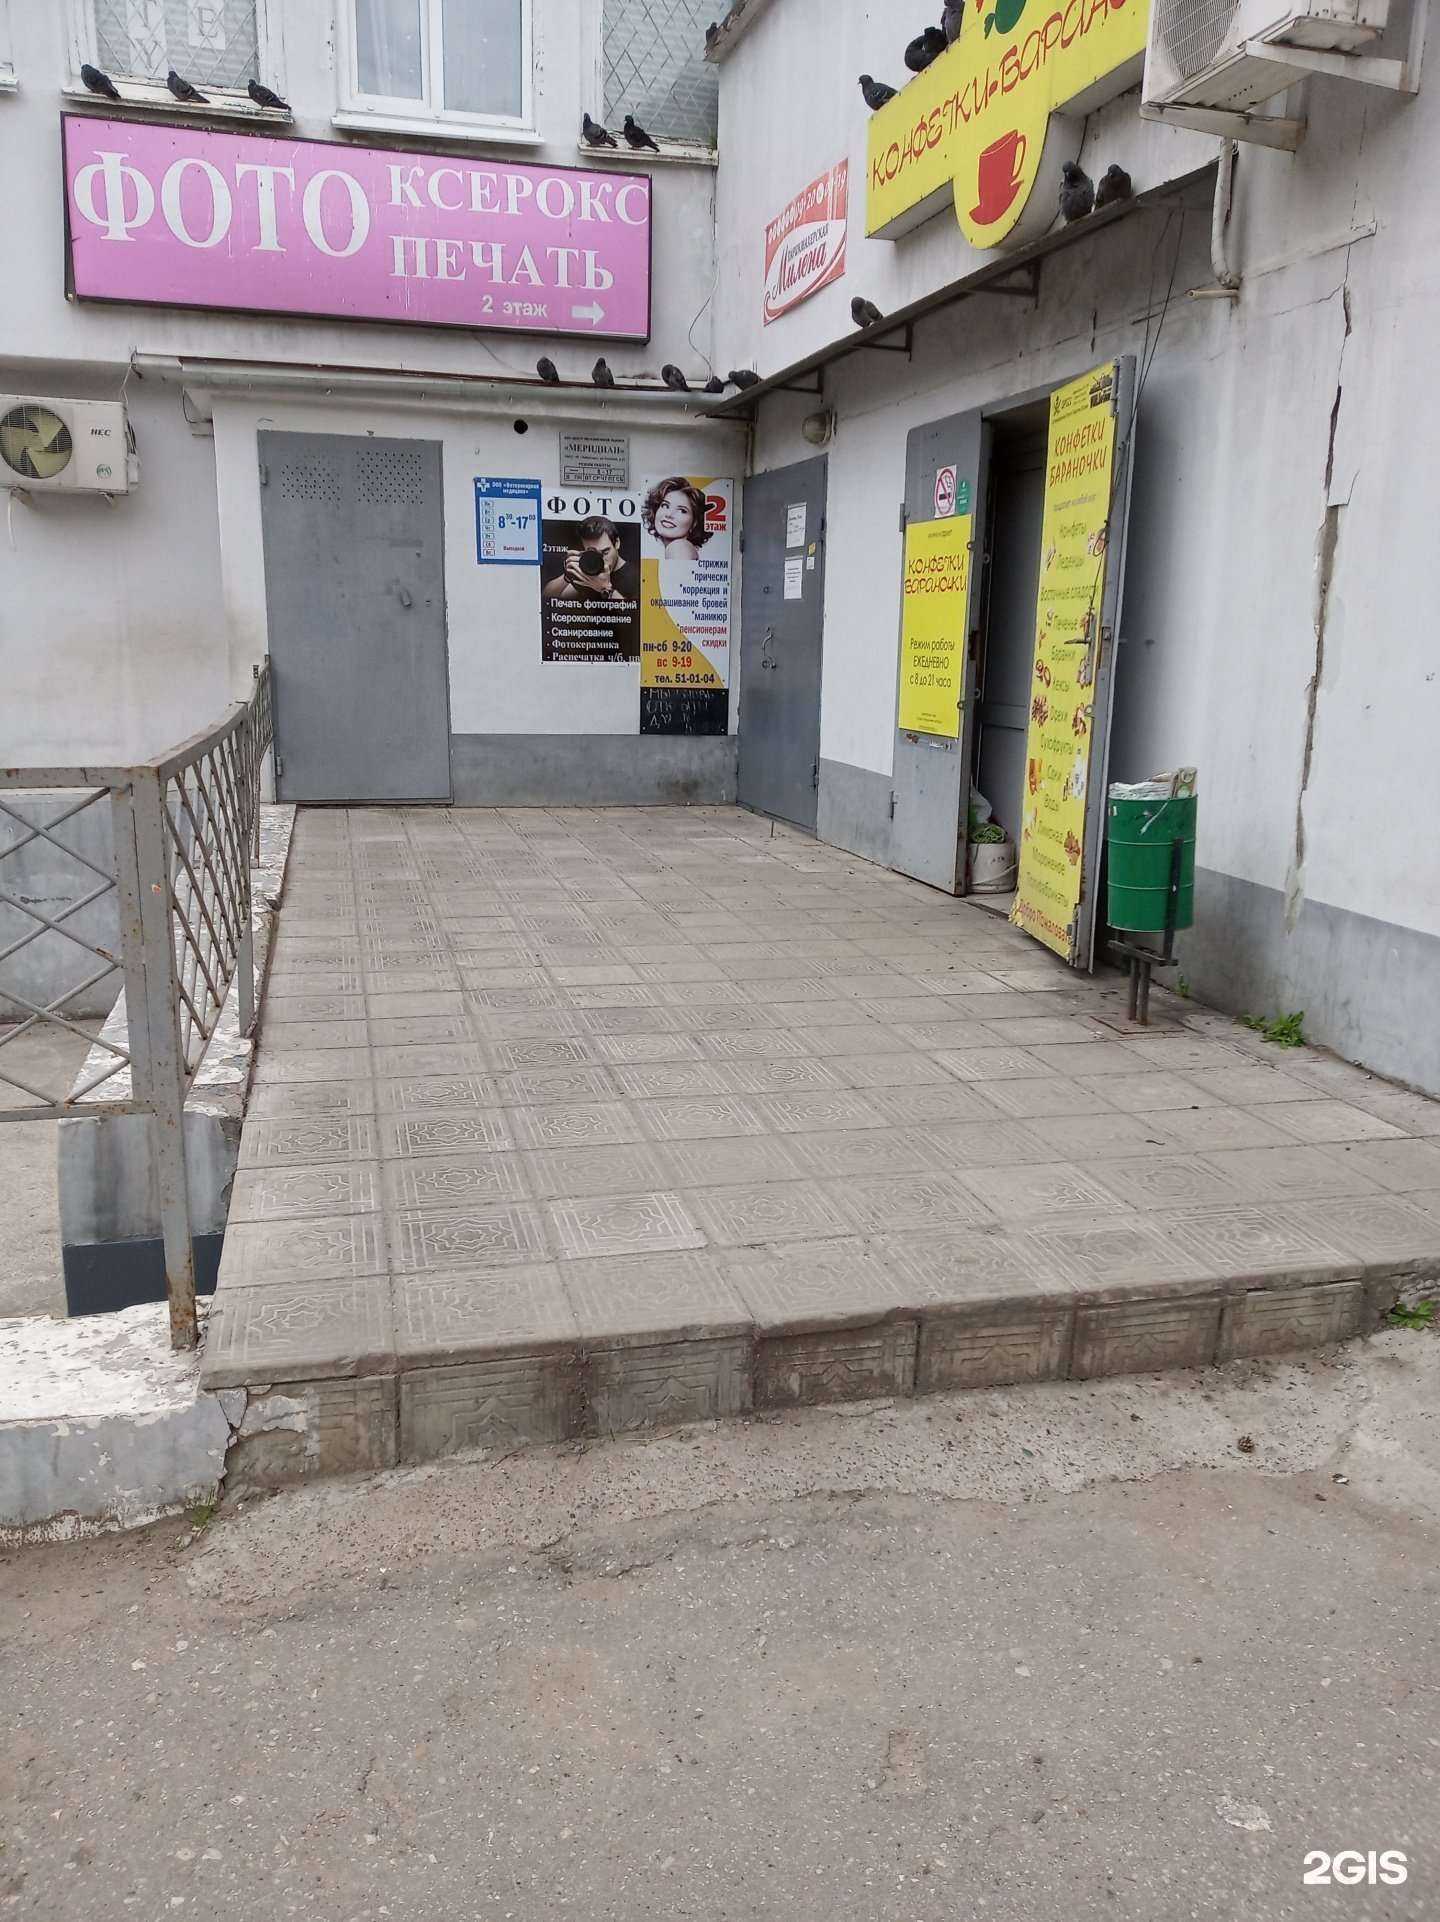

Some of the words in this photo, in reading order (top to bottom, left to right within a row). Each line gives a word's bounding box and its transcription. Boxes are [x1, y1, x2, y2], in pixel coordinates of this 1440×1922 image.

[872, 0, 1126, 192] КОНФЕТКИ-БАРАН
[386, 164, 649, 225] КСЕРОКС
[73, 150, 370, 257] ФОТО
[388, 235, 615, 290] ПЕЧАТЬ
[482, 295, 494, 314] 2
[503, 301, 549, 318] этаж
[1055, 417, 1106, 457] КОНФЕТКИ
[1049, 446, 1108, 488] БАРАНОЧКИ
[547, 496, 636, 517] ФОТО
[705, 495, 726, 522] 2
[704, 523, 726, 532] этаж
[543, 543, 568, 553] 2этаж
[908, 553, 965, 575] КОНФЕТКИ
[904, 575, 967, 595] БАРАНОЧКИ
[550, 598, 582, 609] Печать
[584, 599, 638, 611] фотографий
[650, 598, 699, 608] окрашивание
[702, 597, 728, 609] бровей
[551, 612, 632, 624] Ксерокопирование
[551, 627, 614, 638] Сканирование
[552, 639, 619, 650] Фотокерамика
[642, 640, 668, 652] пн-сб
[672, 641, 692, 652] 9-20
[701, 639, 727, 649] скидки
[910, 638, 931, 651] Режим
[931, 638, 955, 653] работы
[552, 652, 604, 662] Распечатка
[656, 658, 668, 667] вс
[672, 656, 692, 668] 9-19
[913, 655, 950, 670] ЕЖЕДНЕВНО
[654, 675, 673, 683] тел.
[675, 673, 715, 684] 51-01-04
[914, 673, 919, 685] 8
[919, 676, 927, 686] до
[927, 674, 935, 687] 21
